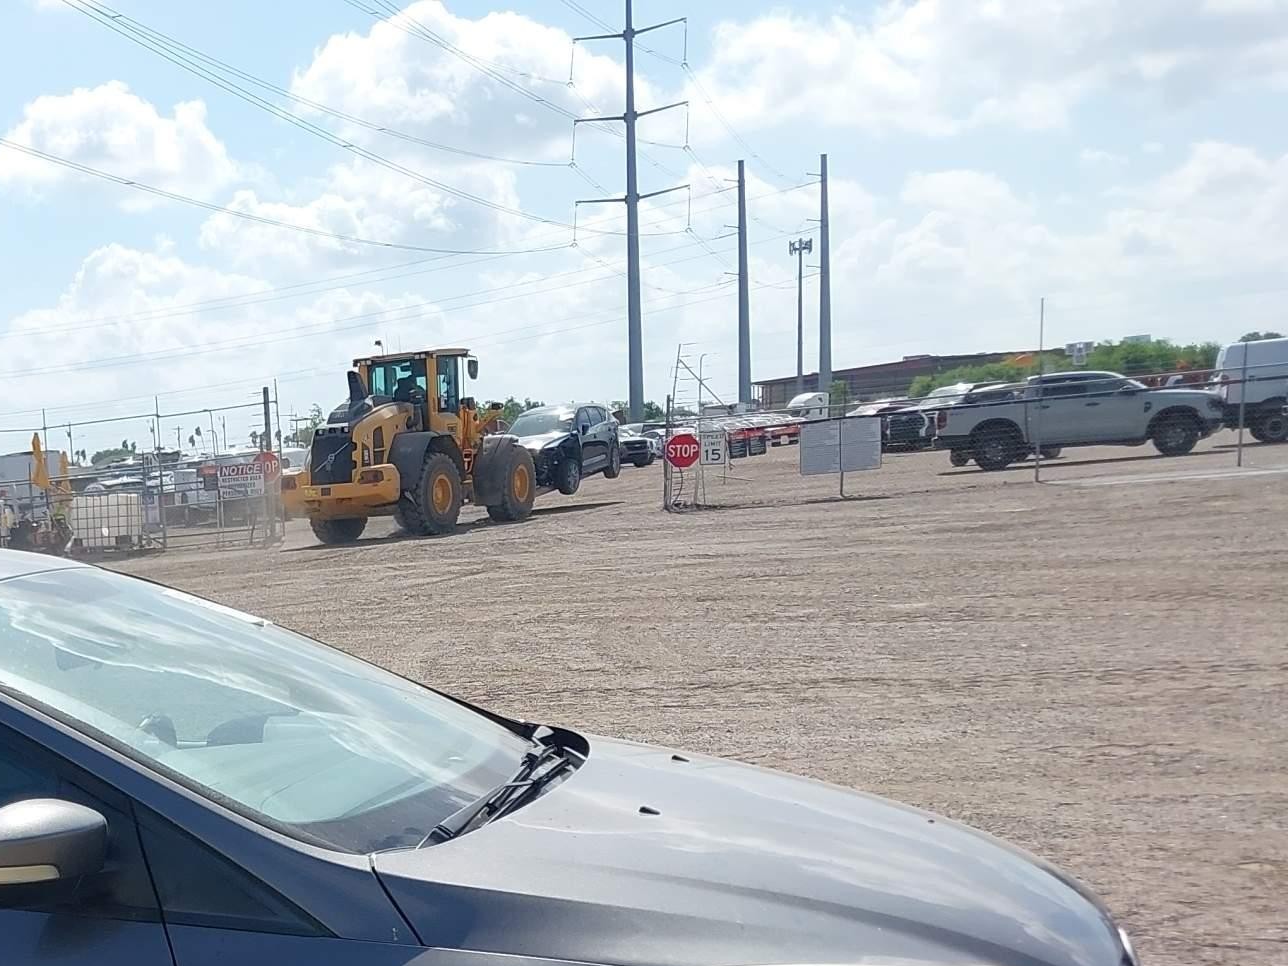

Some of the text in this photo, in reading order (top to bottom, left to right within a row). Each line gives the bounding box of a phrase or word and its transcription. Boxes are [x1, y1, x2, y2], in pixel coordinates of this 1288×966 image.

[668, 444, 698, 458] STOP
[704, 449, 721, 461] 15
[222, 464, 260, 476] NOTICE
